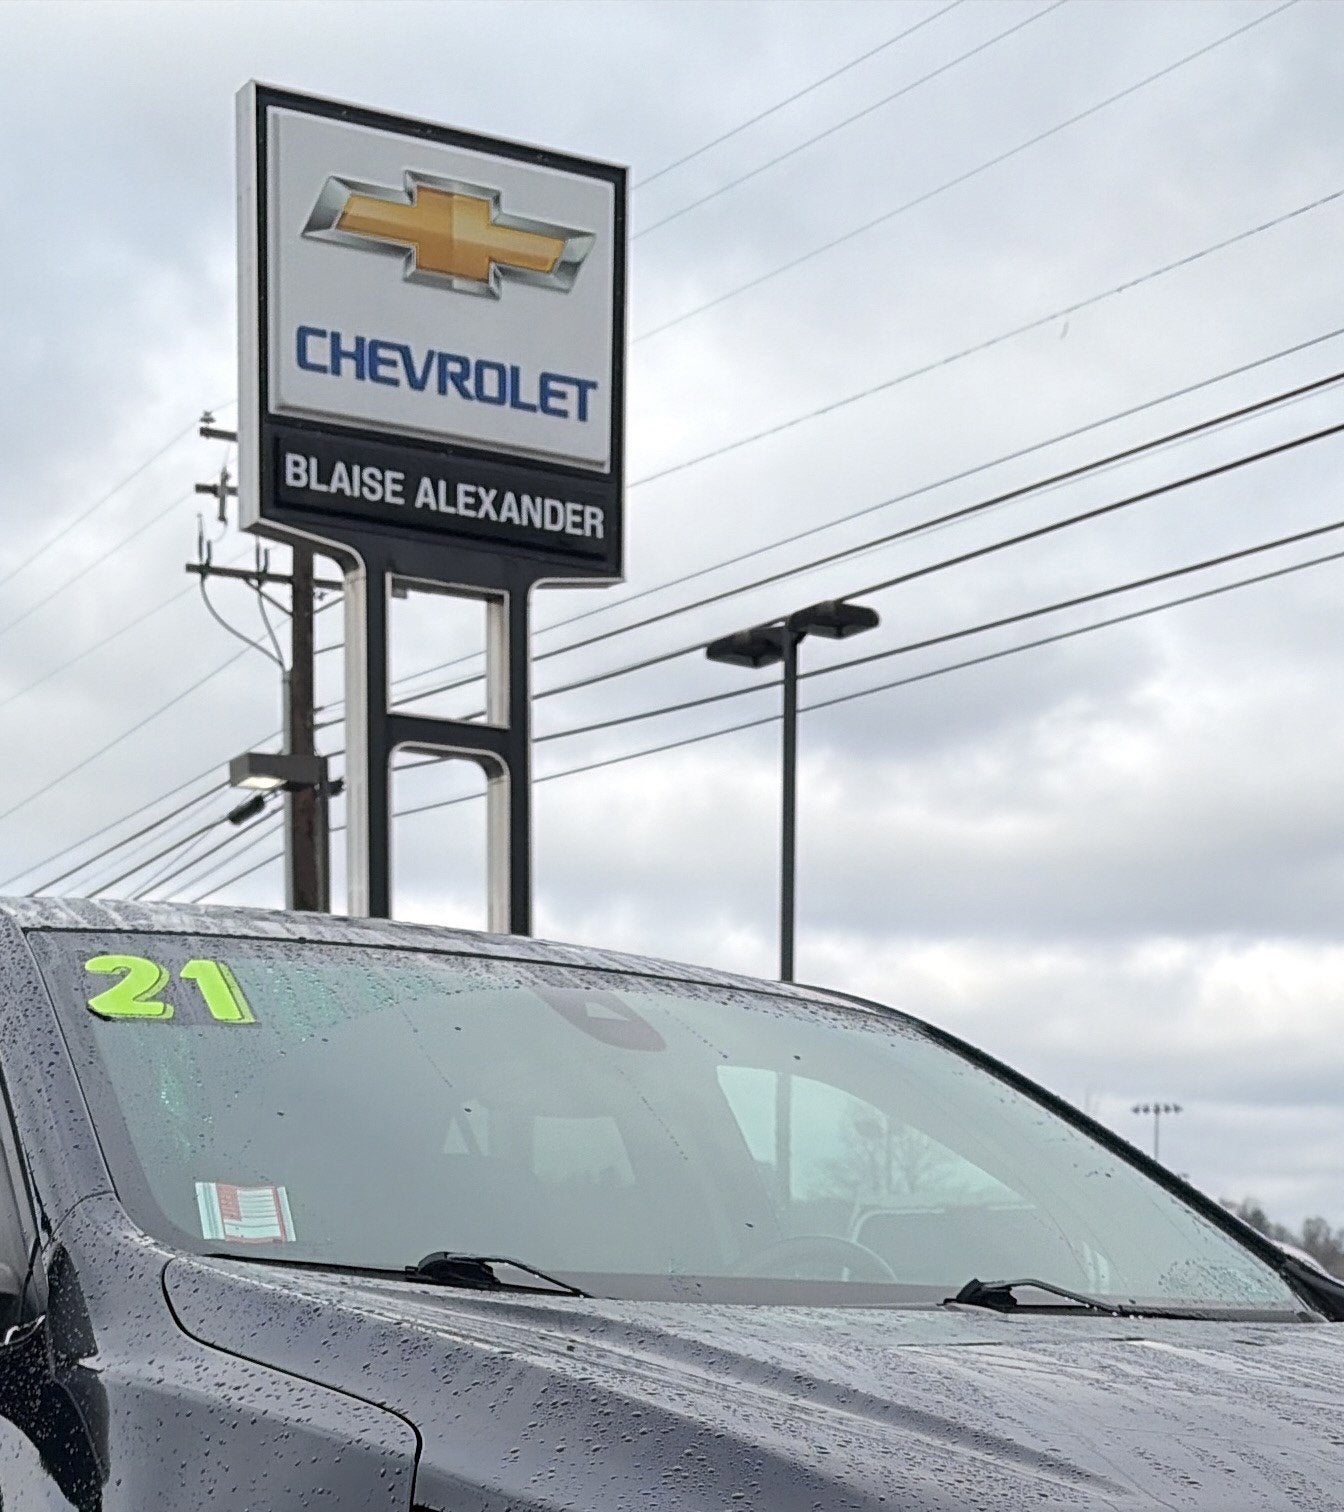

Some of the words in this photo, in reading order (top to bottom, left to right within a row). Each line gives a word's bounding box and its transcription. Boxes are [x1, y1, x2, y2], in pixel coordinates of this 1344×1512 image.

[296, 325, 598, 421] CHEVROLET
[285, 453, 404, 505] BLAISE
[415, 476, 604, 539] ALEXANDER
[85, 955, 256, 1023] 21
